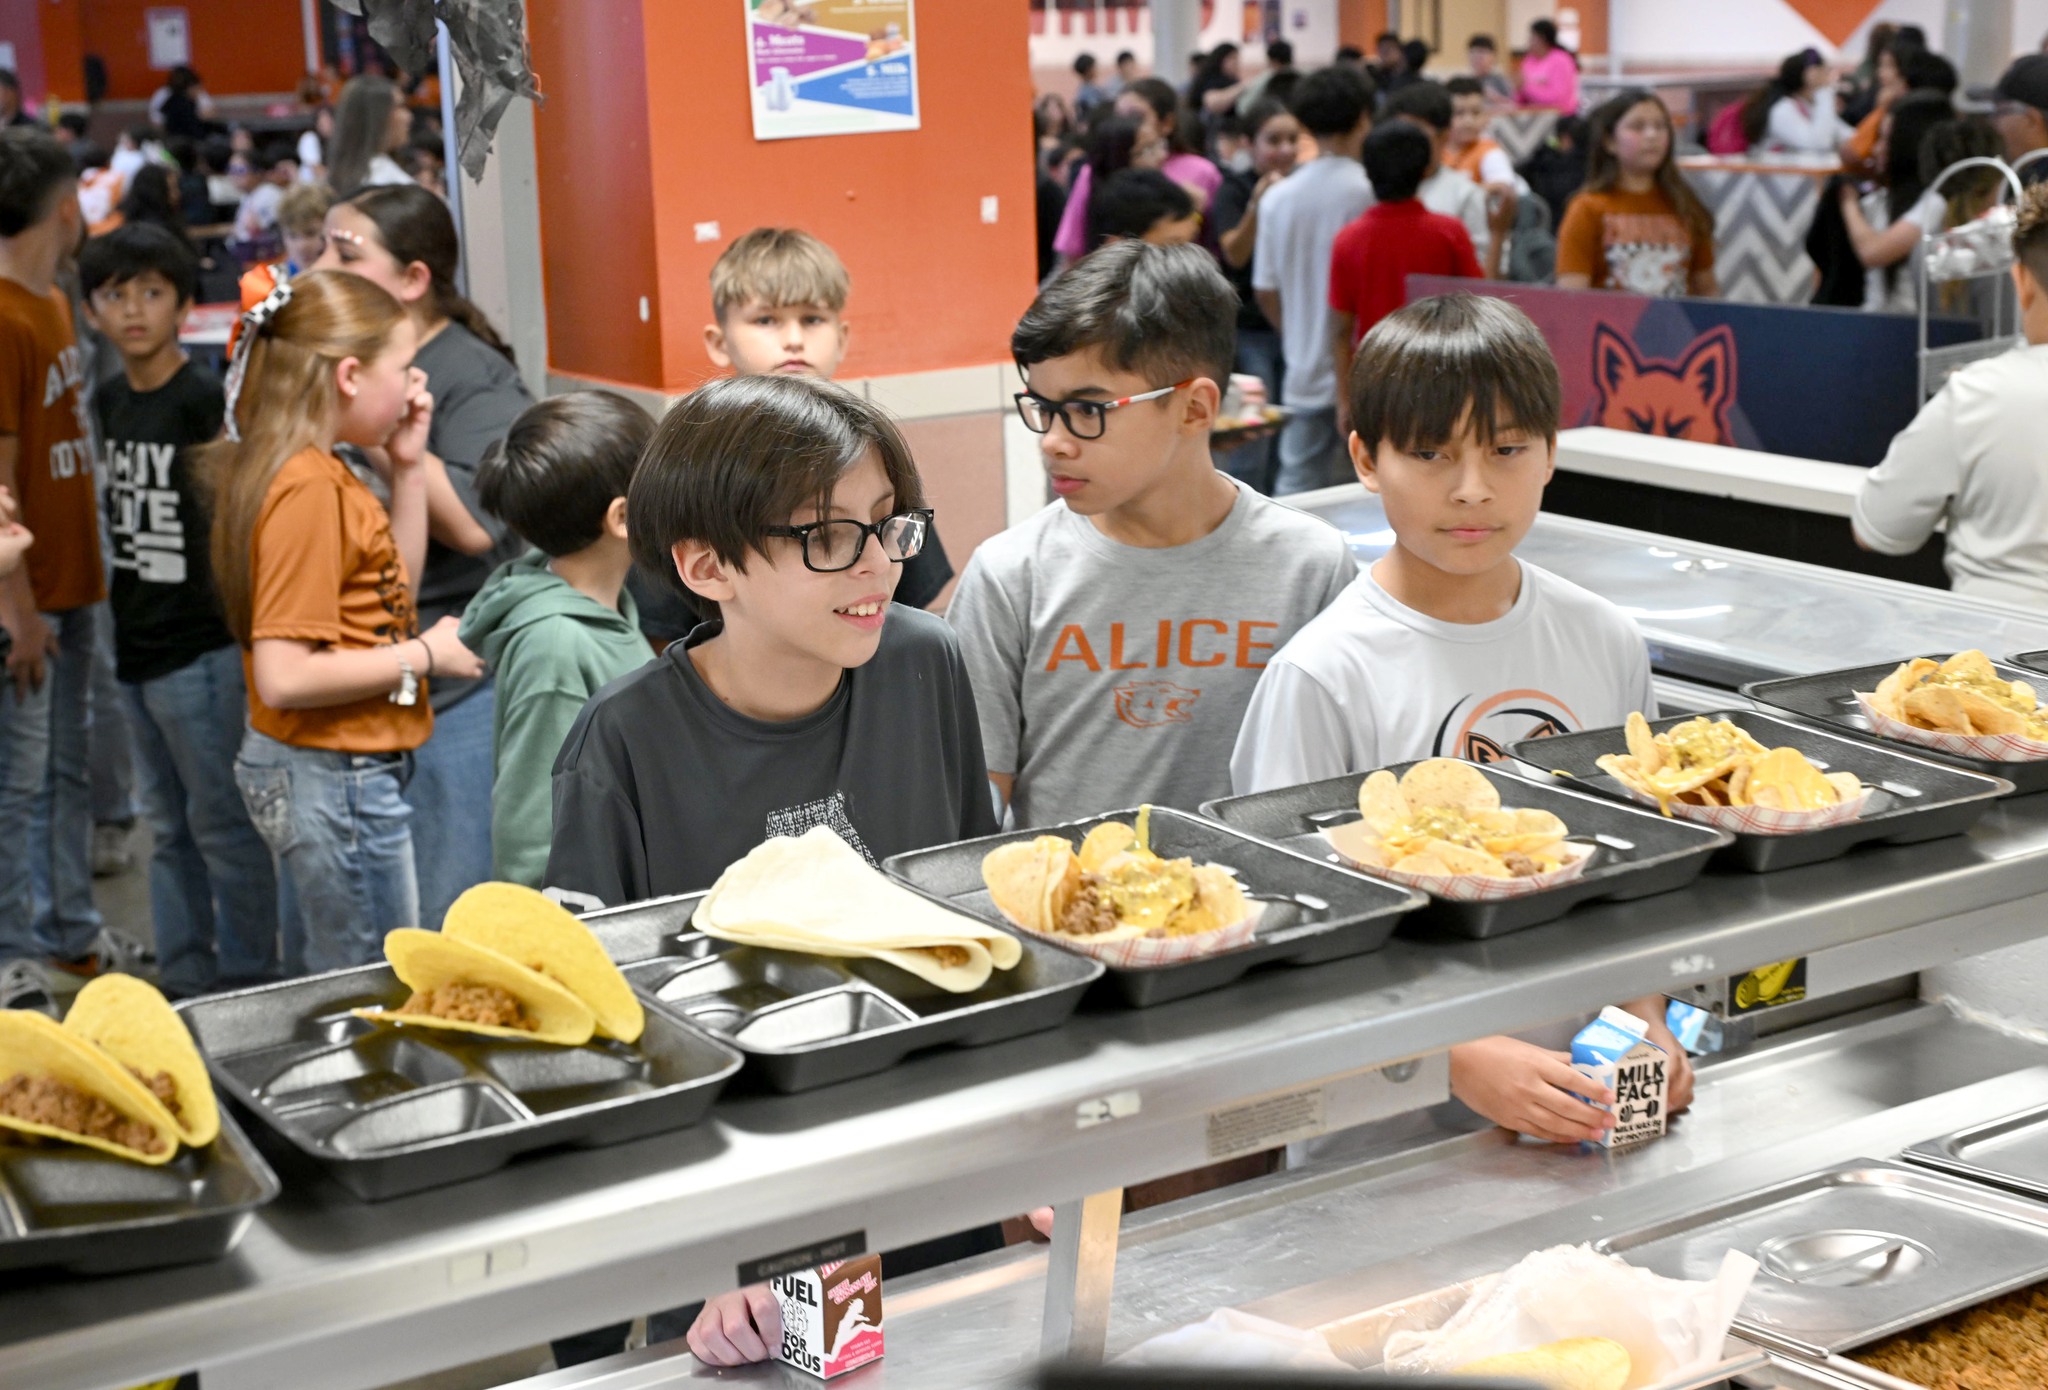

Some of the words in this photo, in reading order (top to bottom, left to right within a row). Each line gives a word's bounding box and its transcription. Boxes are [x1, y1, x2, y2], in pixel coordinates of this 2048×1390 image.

[1045, 618, 1279, 673] ALICE
[1617, 1060, 1665, 1085] MILK
[1615, 1079, 1665, 1104] FACT
[772, 1274, 818, 1308] FUEL
[784, 1331, 808, 1353] FOR
[781, 1343, 822, 1373] OCUS
